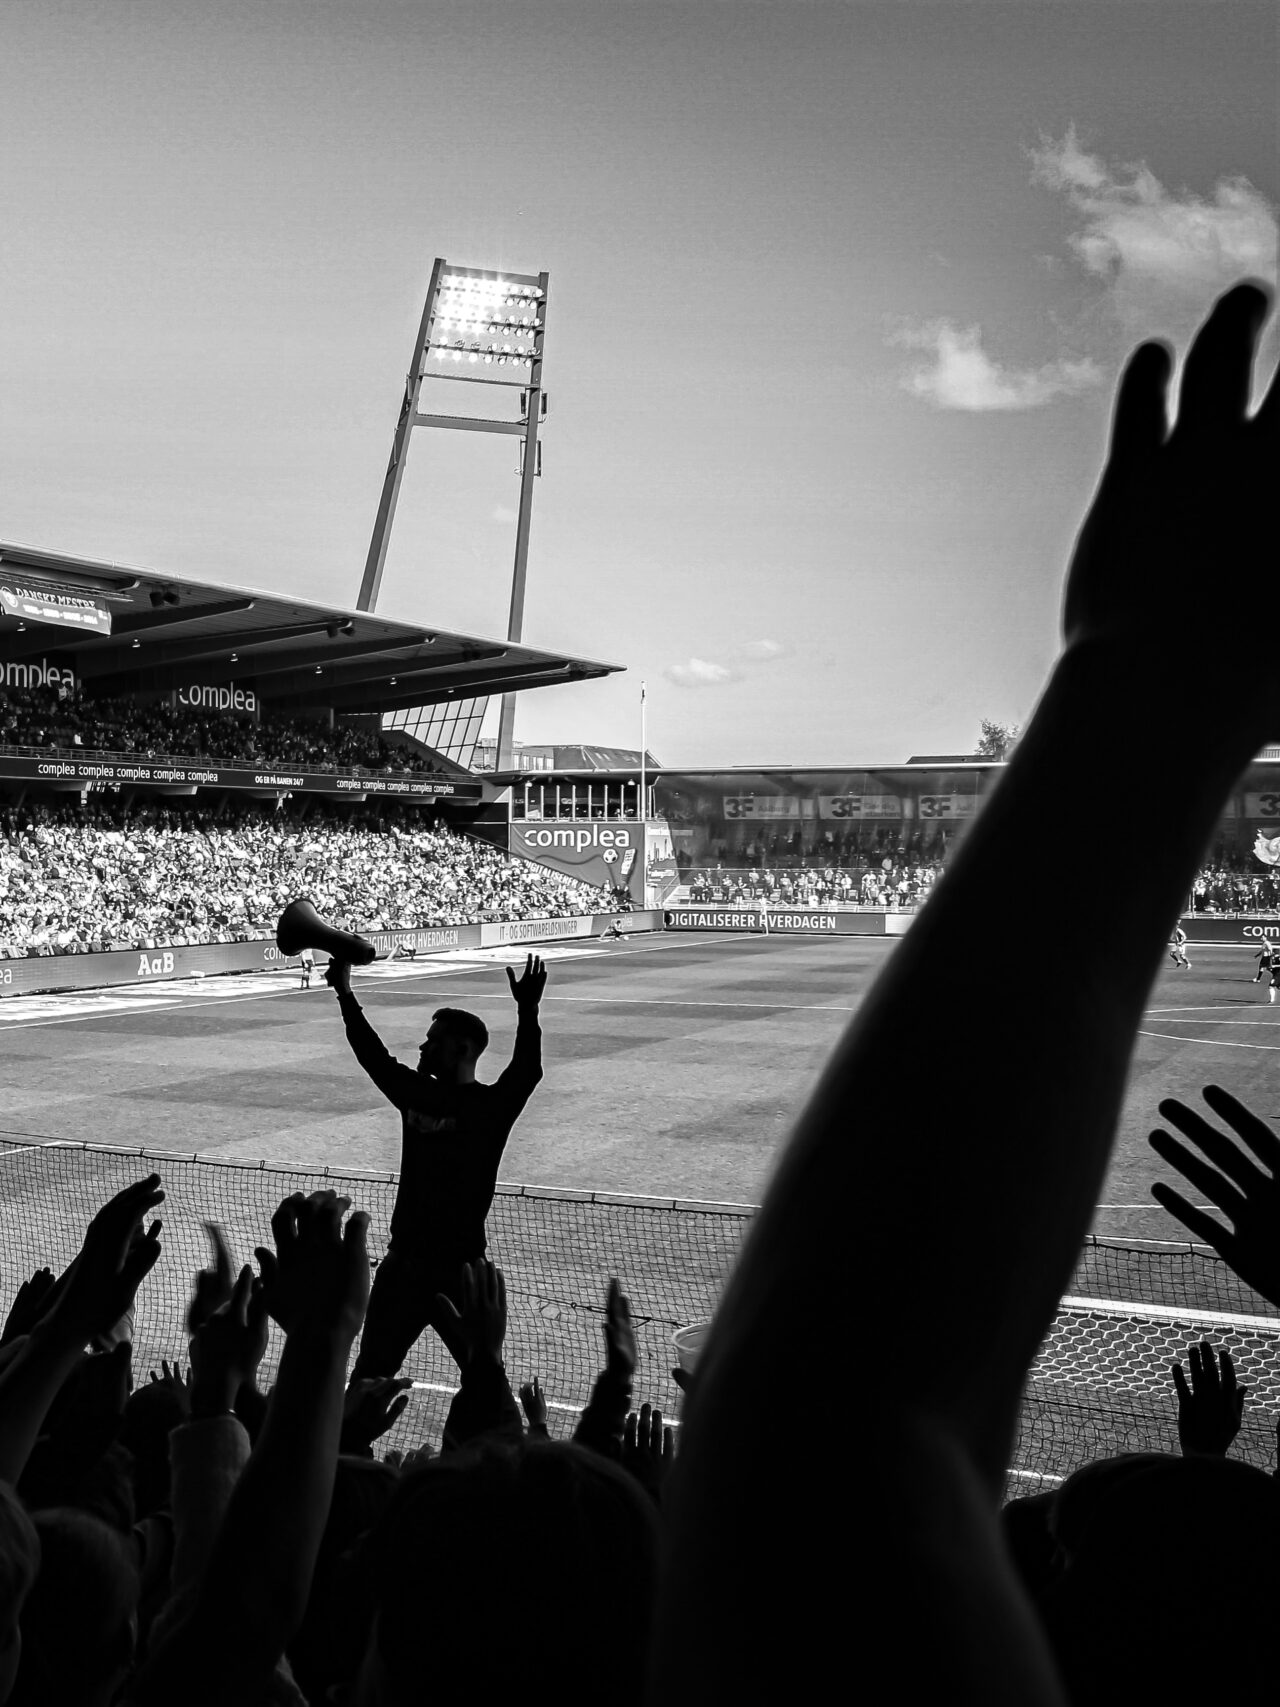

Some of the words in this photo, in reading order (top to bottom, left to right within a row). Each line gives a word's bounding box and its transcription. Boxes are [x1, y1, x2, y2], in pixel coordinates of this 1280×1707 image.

[38, 762, 76, 777] complea
[78, 764, 114, 779] complea
[116, 766, 151, 781] complea
[153, 768, 185, 782] complea
[187, 770, 218, 784] complea
[254, 775, 263, 784] OG
[336, 779, 361, 790] complea
[362, 780, 386, 791] complea
[387, 781, 410, 792] complea
[410, 782, 433, 793] complea
[433, 783, 455, 794] complea
[725, 798, 754, 818] 3F
[831, 797, 862, 818] 3F
[921, 796, 951, 817] 3F
[1259, 794, 1280, 816] 3
[524, 824, 630, 853] complea
[499, 926, 506, 940] IT
[509, 925, 518, 940] OG
[519, 920, 578, 939] SOFTWARELØSNINGER
[758, 914, 836, 930] HVERDAGEN
[417, 930, 459, 948] HVERDAGEN
[137, 952, 175, 976] AaB
